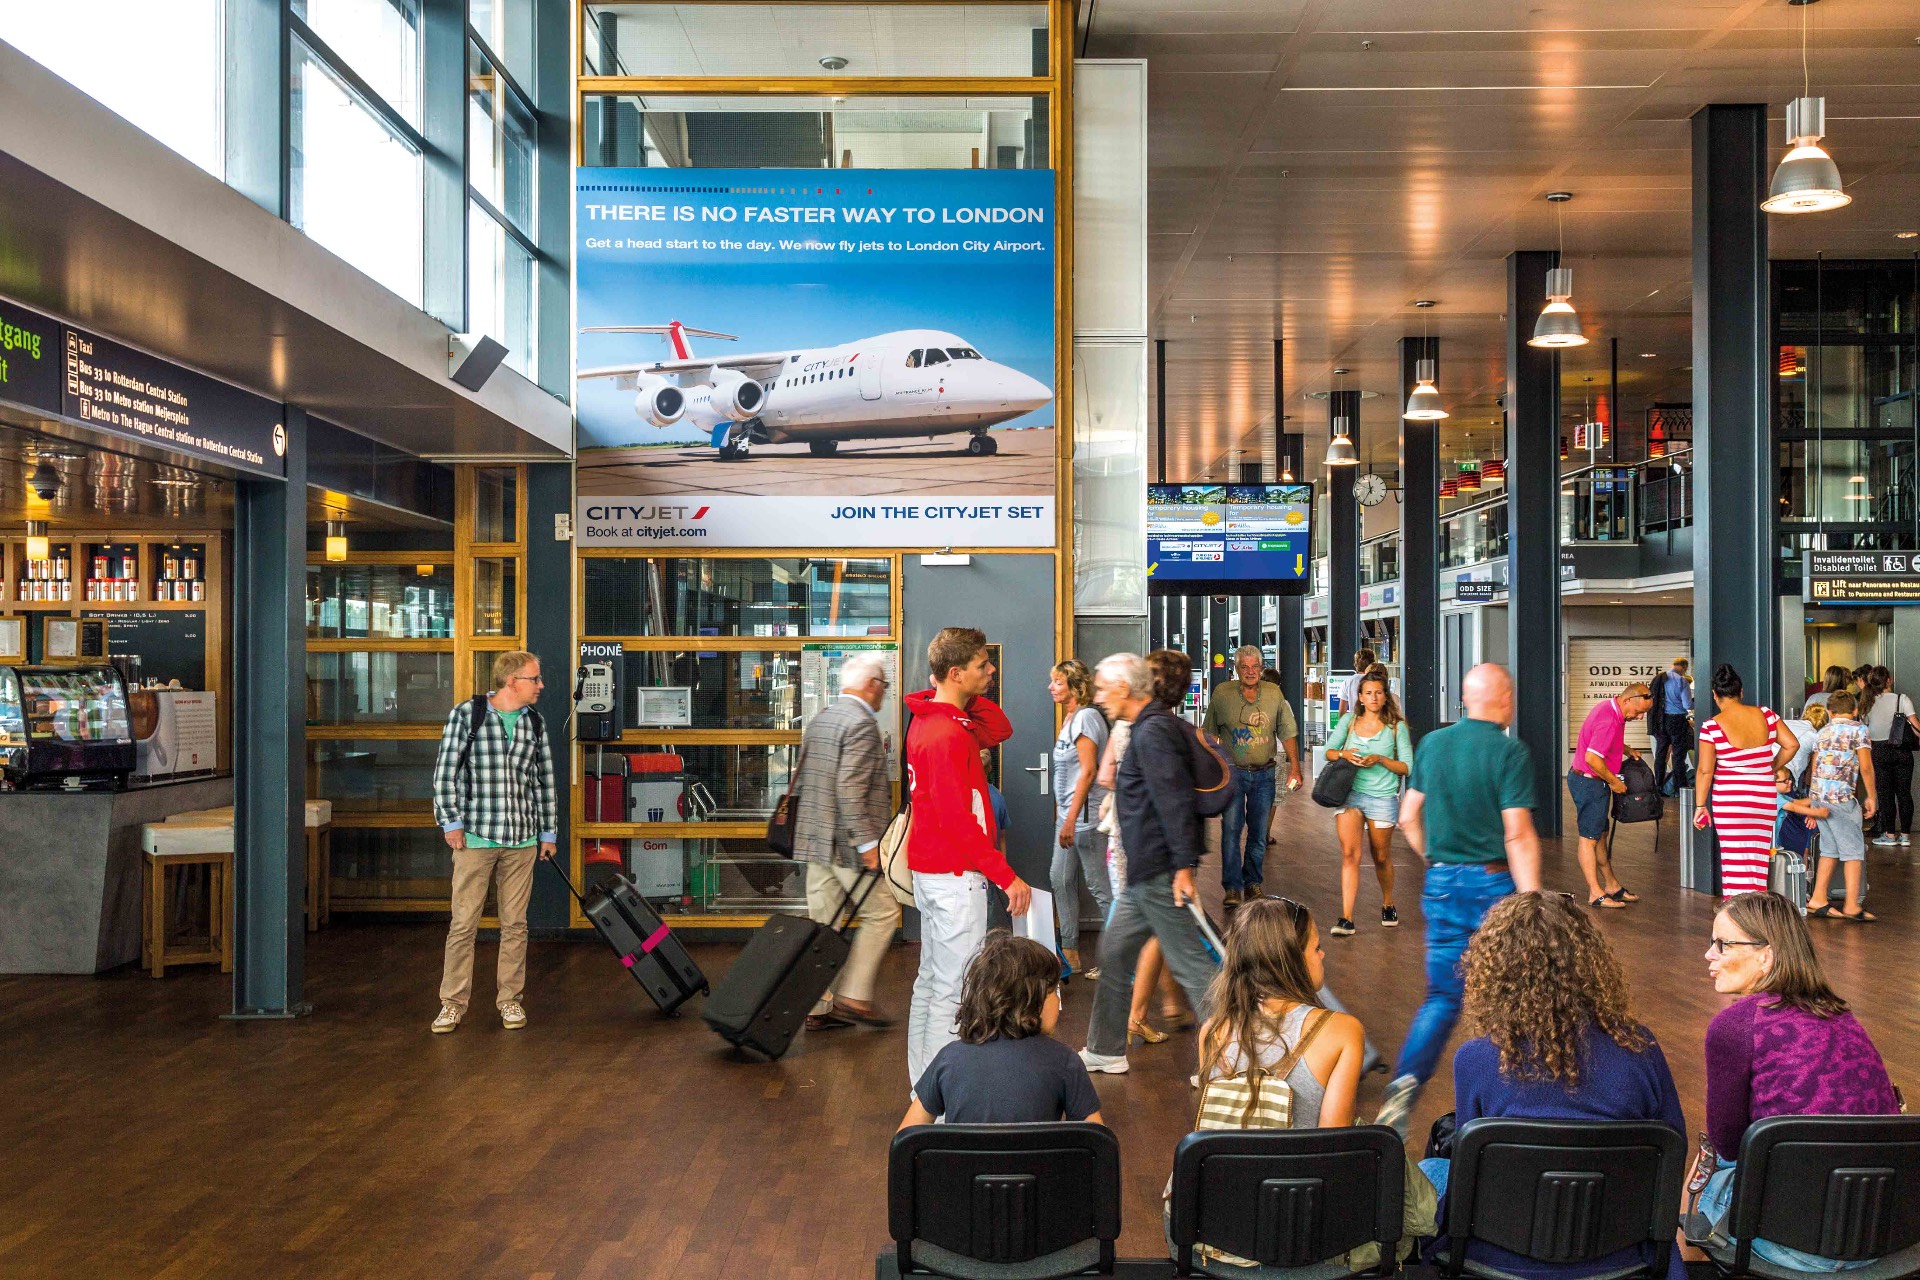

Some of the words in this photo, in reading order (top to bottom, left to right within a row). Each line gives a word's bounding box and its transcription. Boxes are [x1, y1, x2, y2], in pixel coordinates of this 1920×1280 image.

[585, 204, 666, 221] THERE
[673, 205, 695, 222] IS
[701, 206, 737, 222] NO
[744, 206, 836, 223] FASTER
[841, 207, 897, 223] WAY
[902, 207, 936, 223] TO
[942, 207, 1044, 224] LONDON
[585, 237, 611, 249] Get
[614, 240, 623, 249] a
[627, 238, 662, 249] head
[666, 238, 698, 250] start
[702, 239, 716, 250] to
[719, 238, 742, 250] the
[746, 239, 775, 253] day.
[779, 240, 802, 251] We
[805, 242, 836, 251] now
[839, 240, 856, 254] fly
[857, 240, 885, 254] jets
[887, 241, 902, 252] to
[906, 240, 959, 252] London
[962, 240, 990, 254] City
[993, 240, 1045, 254] Airport.
[79, 339, 93, 355] Taxi
[803, 355, 850, 372] CITYJET
[80, 360, 92, 376] Bus
[94, 368, 103, 381] 33
[104, 369, 111, 382] to
[113, 371, 145, 393] Rotterdam
[146, 382, 167, 401] Central
[168, 389, 188, 407] Station
[80, 381, 93, 397] Bus
[94, 388, 103, 402] 33
[104, 389, 112, 402] to
[113, 391, 132, 408] Metro
[133, 401, 154, 415] station
[155, 406, 189, 426] Meijersplein
[92, 405, 110, 421] Metro
[112, 411, 119, 424] to
[121, 414, 133, 429] The
[134, 419, 153, 434] Hague
[154, 424, 175, 440] Central
[175, 431, 195, 446] station
[195, 437, 202, 447] or
[203, 437, 228, 455] Rotterdam
[229, 445, 246, 460] Central
[246, 450, 263, 465] Station
[586, 506, 689, 520] CITYJET
[831, 506, 876, 519] JOIN
[881, 506, 919, 519] THE
[924, 506, 1003, 519] CITYJET
[1007, 506, 1044, 519] SET
[586, 526, 618, 538] Book
[621, 527, 633, 538] at
[636, 526, 707, 540] cityjet.com
[1813, 556, 1875, 564] Invalidentoilet
[1813, 564, 1850, 572] Disabled
[1853, 564, 1877, 572] Toilet
[1832, 580, 1847, 588] Lift
[1832, 589, 1846, 598] Lift
[580, 645, 622, 657] PHONE
[1589, 665, 1622, 676] ODD
[1629, 665, 1663, 676] SIZE
[643, 841, 668, 851] Gom
